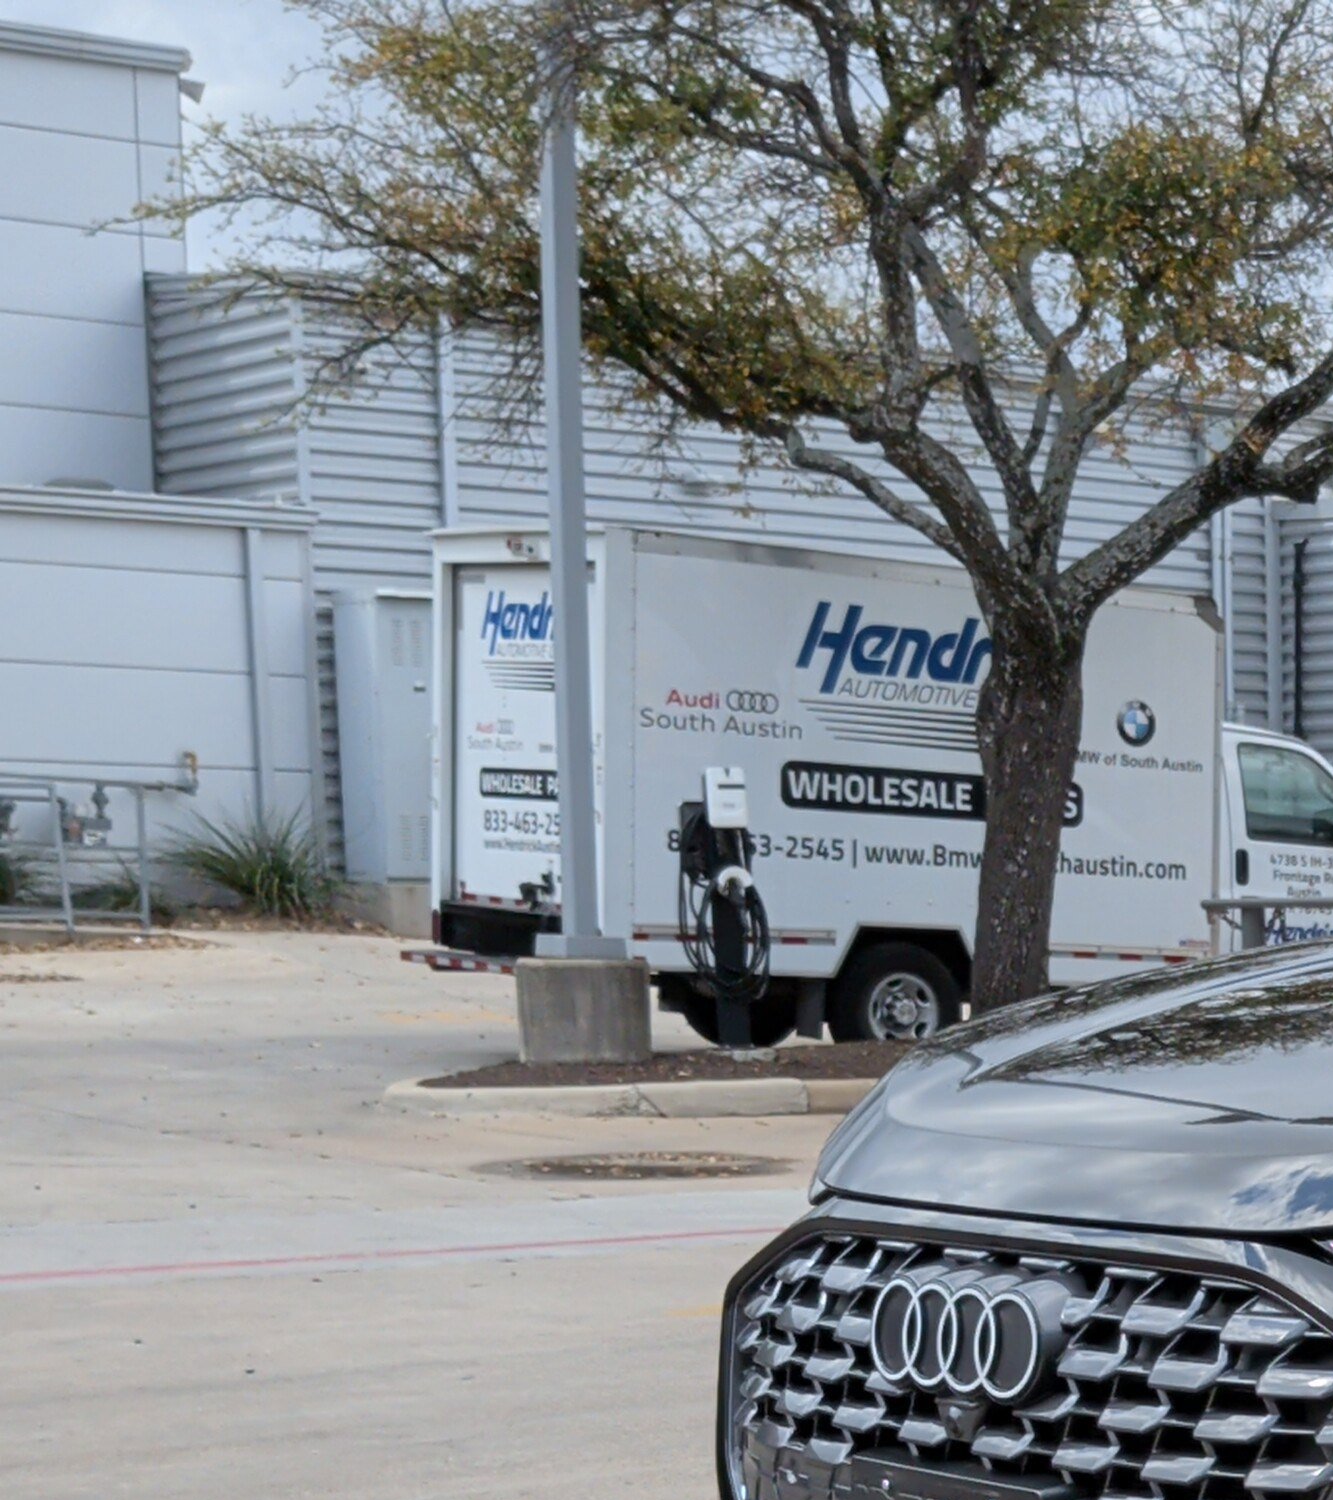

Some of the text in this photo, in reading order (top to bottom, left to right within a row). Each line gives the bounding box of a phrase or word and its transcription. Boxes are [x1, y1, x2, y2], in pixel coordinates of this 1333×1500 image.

[481, 591, 553, 656] Hendr
[795, 600, 992, 694] Hendr
[666, 689, 720, 709] Audi
[838, 678, 979, 708] AUTOMOTIVE
[640, 707, 803, 739] South Austin
[1076, 751, 1203, 773] MW of South Austin
[482, 772, 544, 794] WHOLESALE
[788, 769, 973, 812] WHOLESALE
[484, 809, 560, 836] 833-463-25
